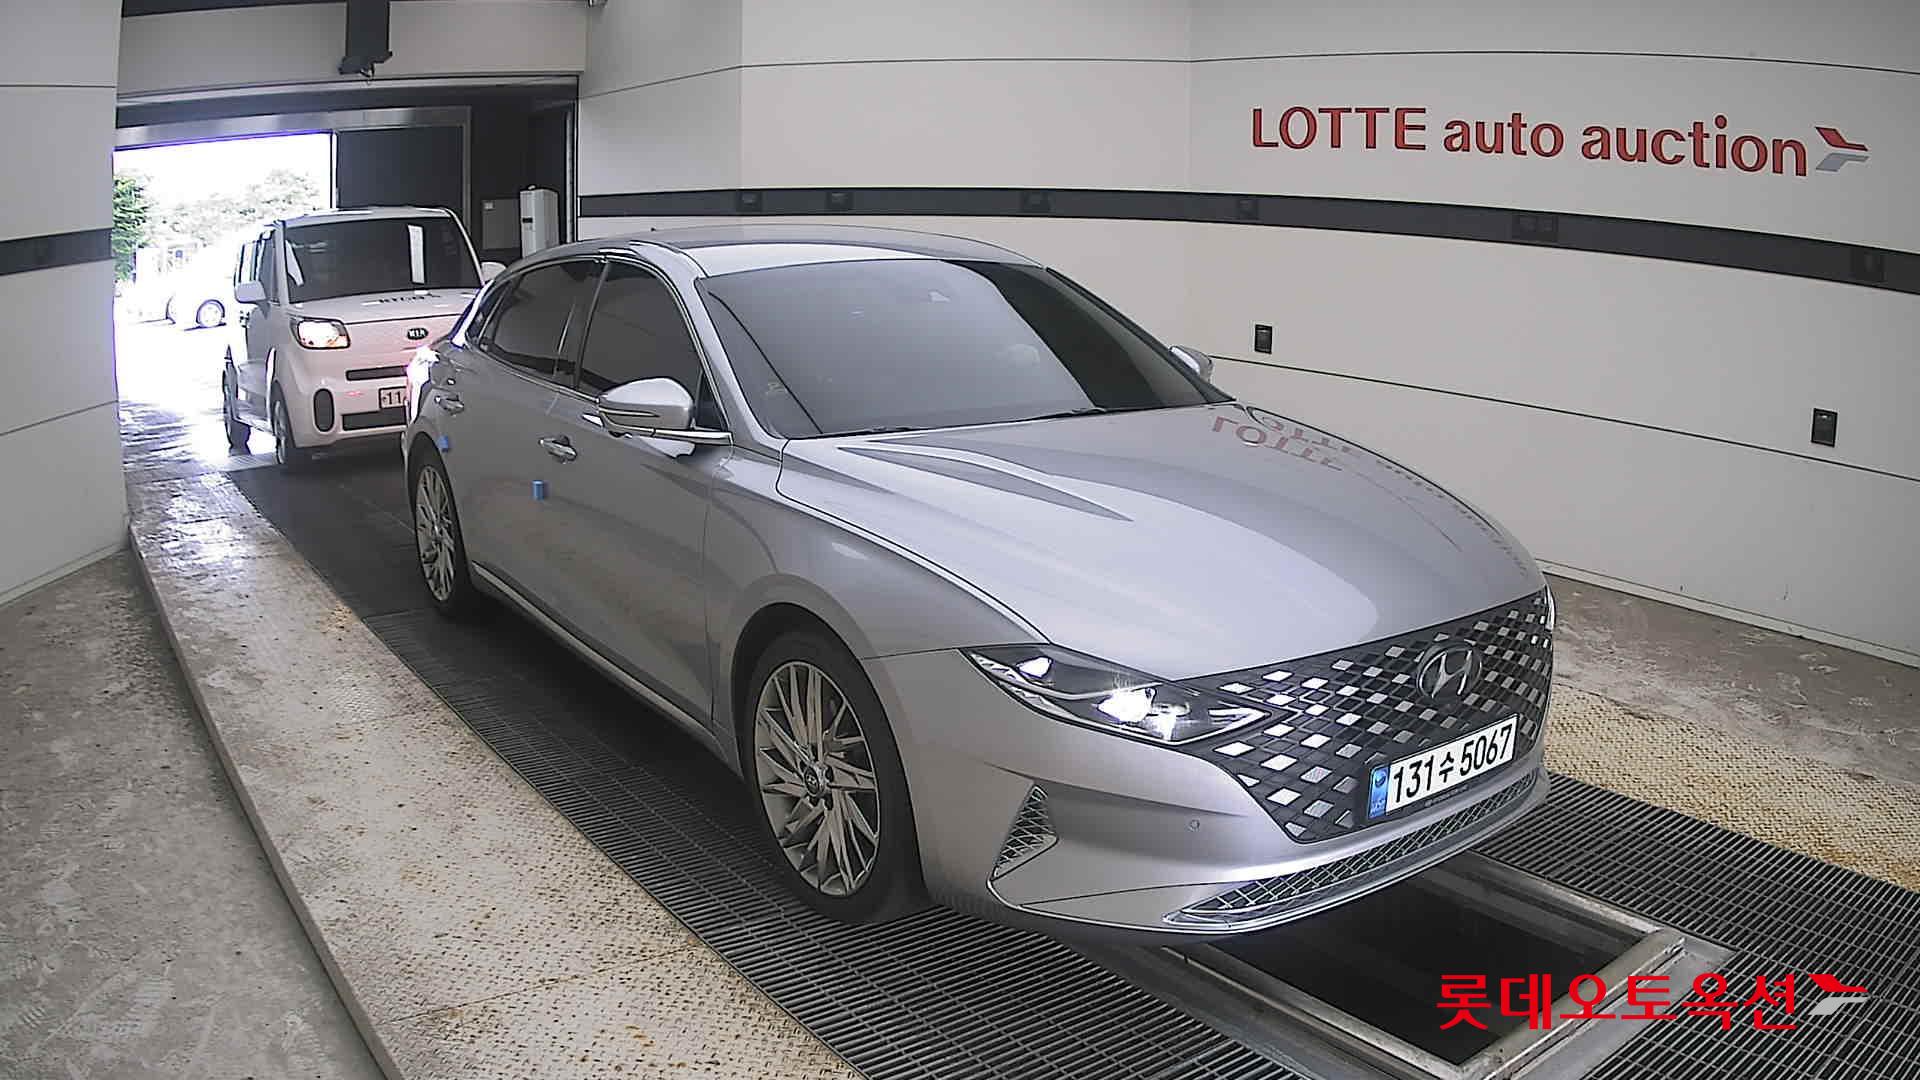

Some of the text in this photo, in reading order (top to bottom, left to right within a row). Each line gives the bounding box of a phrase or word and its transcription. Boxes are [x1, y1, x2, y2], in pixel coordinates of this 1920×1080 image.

[1252, 106, 1808, 178] LOTTE auto auction
[407, 328, 428, 338] KIA
